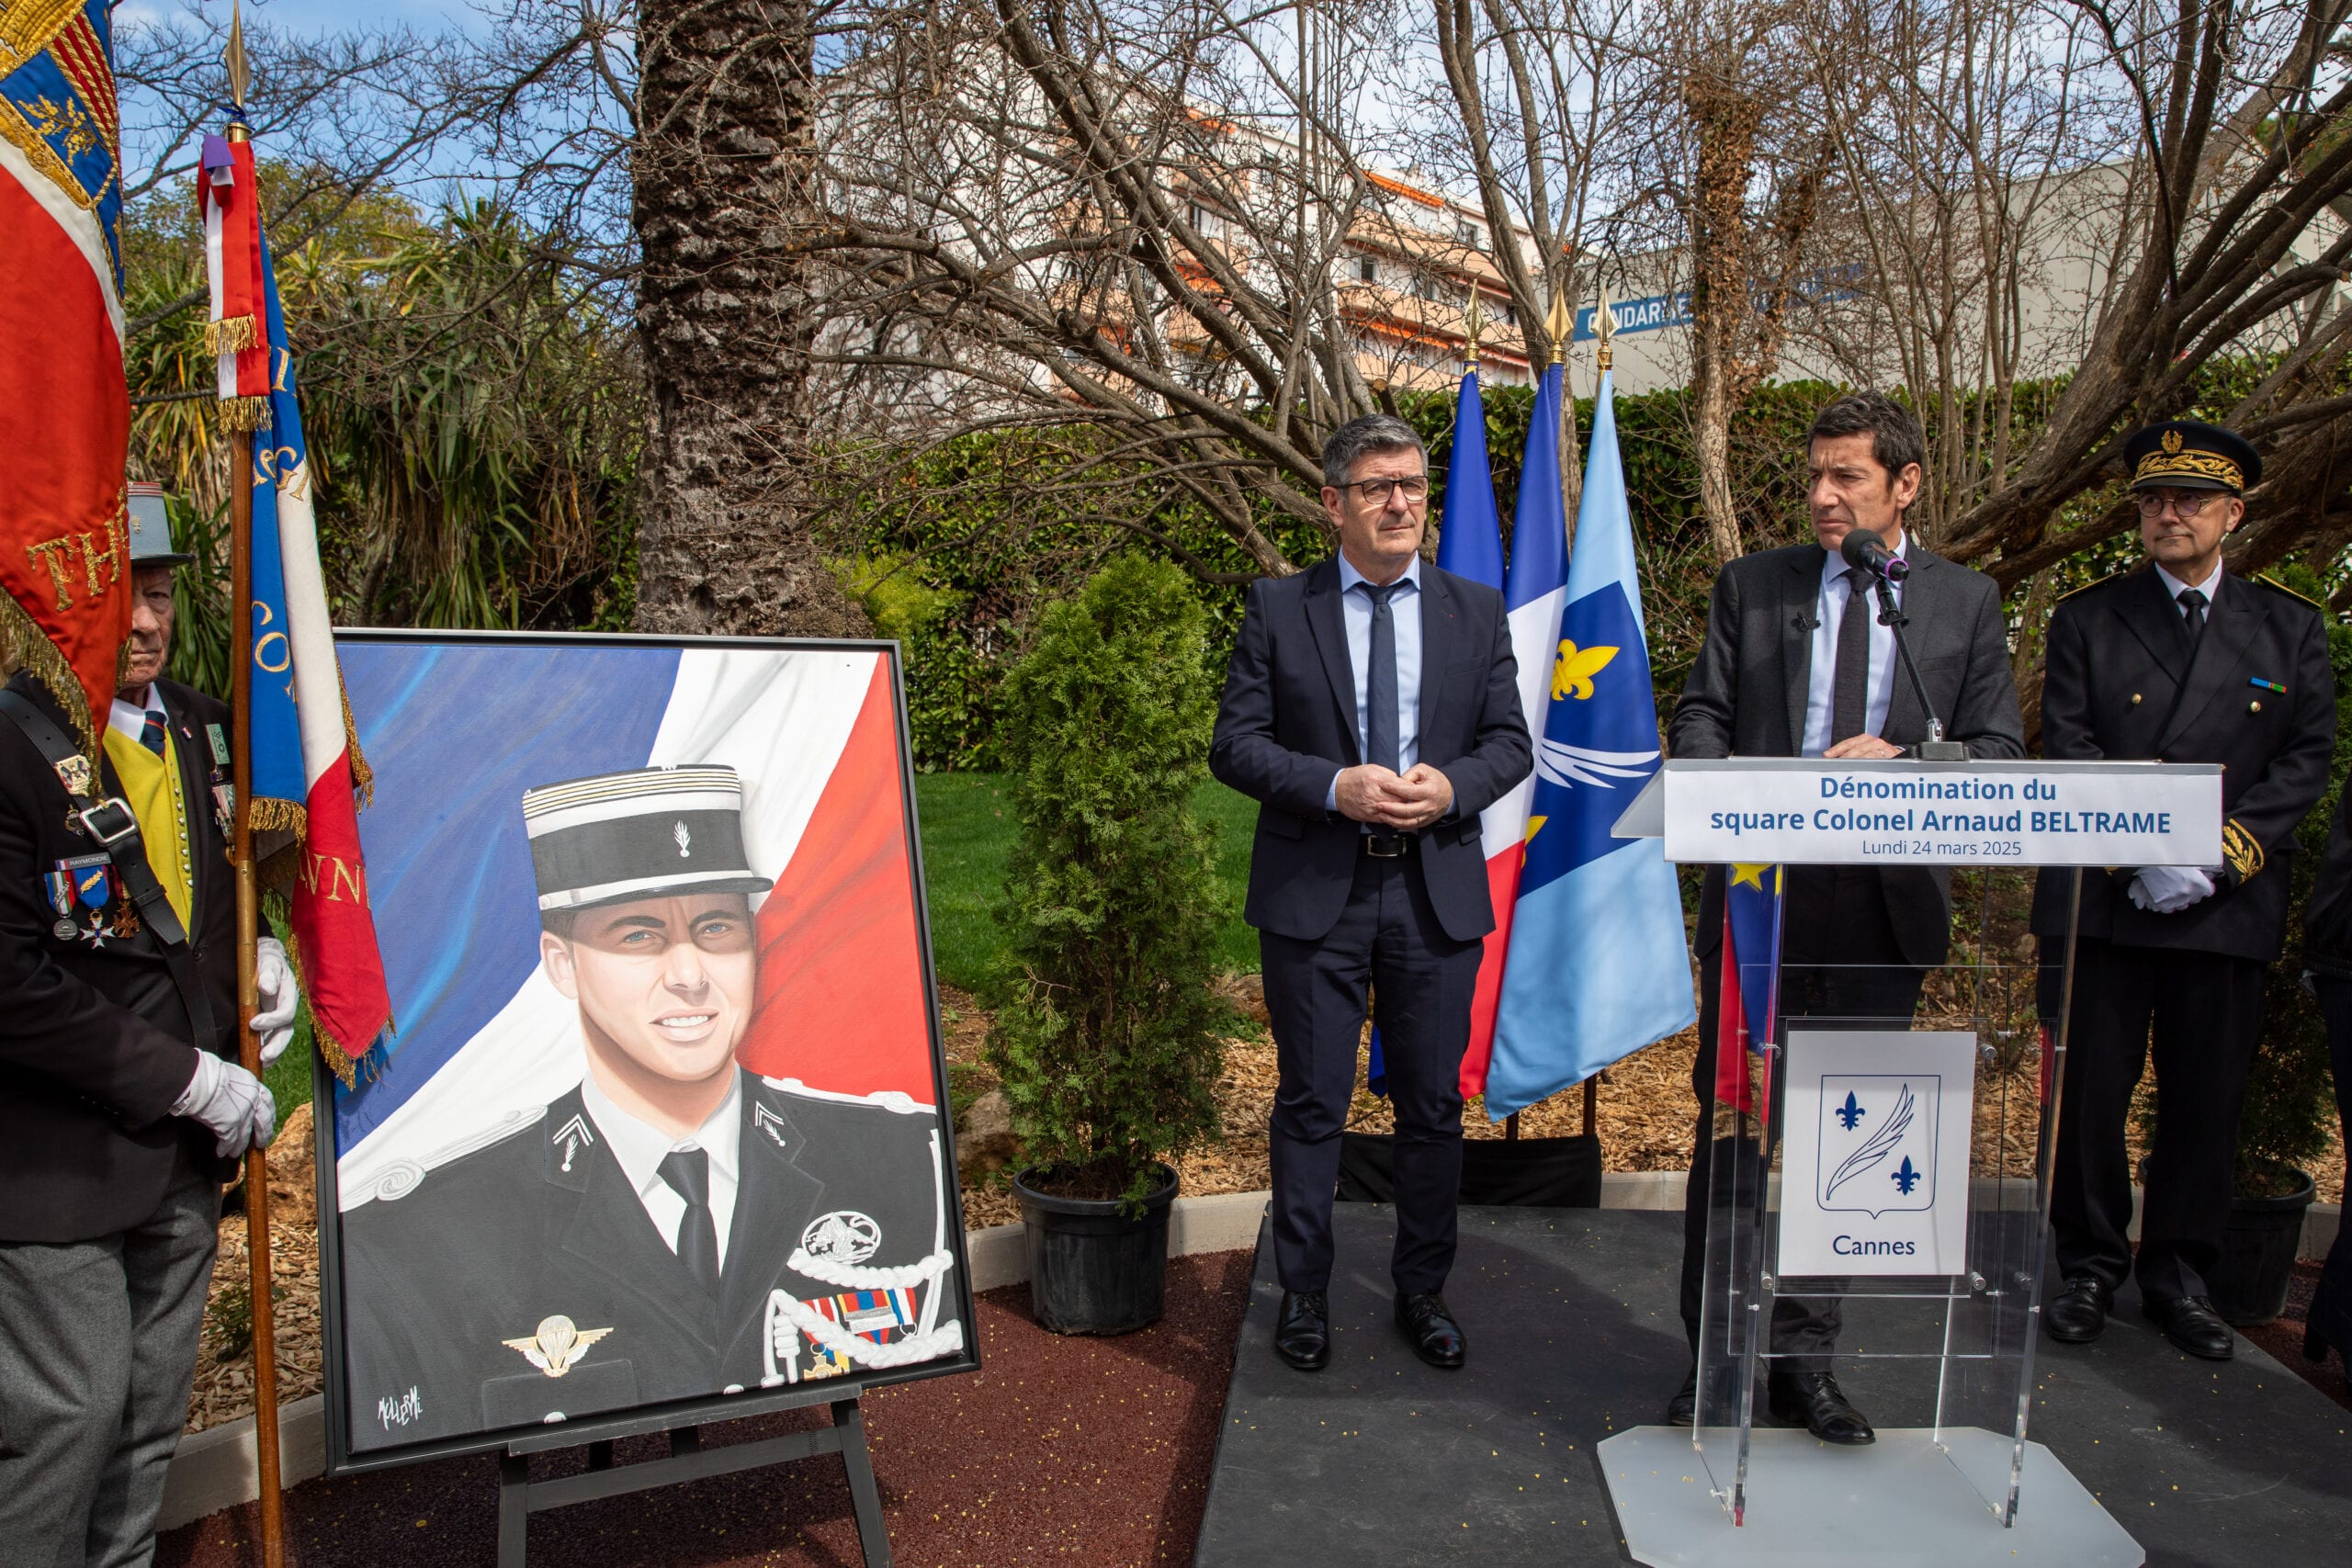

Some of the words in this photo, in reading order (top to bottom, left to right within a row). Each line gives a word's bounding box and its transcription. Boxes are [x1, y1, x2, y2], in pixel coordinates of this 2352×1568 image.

[1820, 775, 2015, 800] Dénomination
[2022, 778, 2057, 801] du
[1711, 811, 1805, 836] square
[1813, 807, 1915, 831] Colonel
[1922, 809, 2022, 833] Arnaud
[2030, 810, 2171, 835] BELTRAME
[1861, 840, 1907, 855] Lundi
[1912, 840, 1932, 855] 24
[1937, 842, 1978, 856] mars
[1982, 840, 2022, 856] 2025
[1832, 1235, 1916, 1256] Cannes
